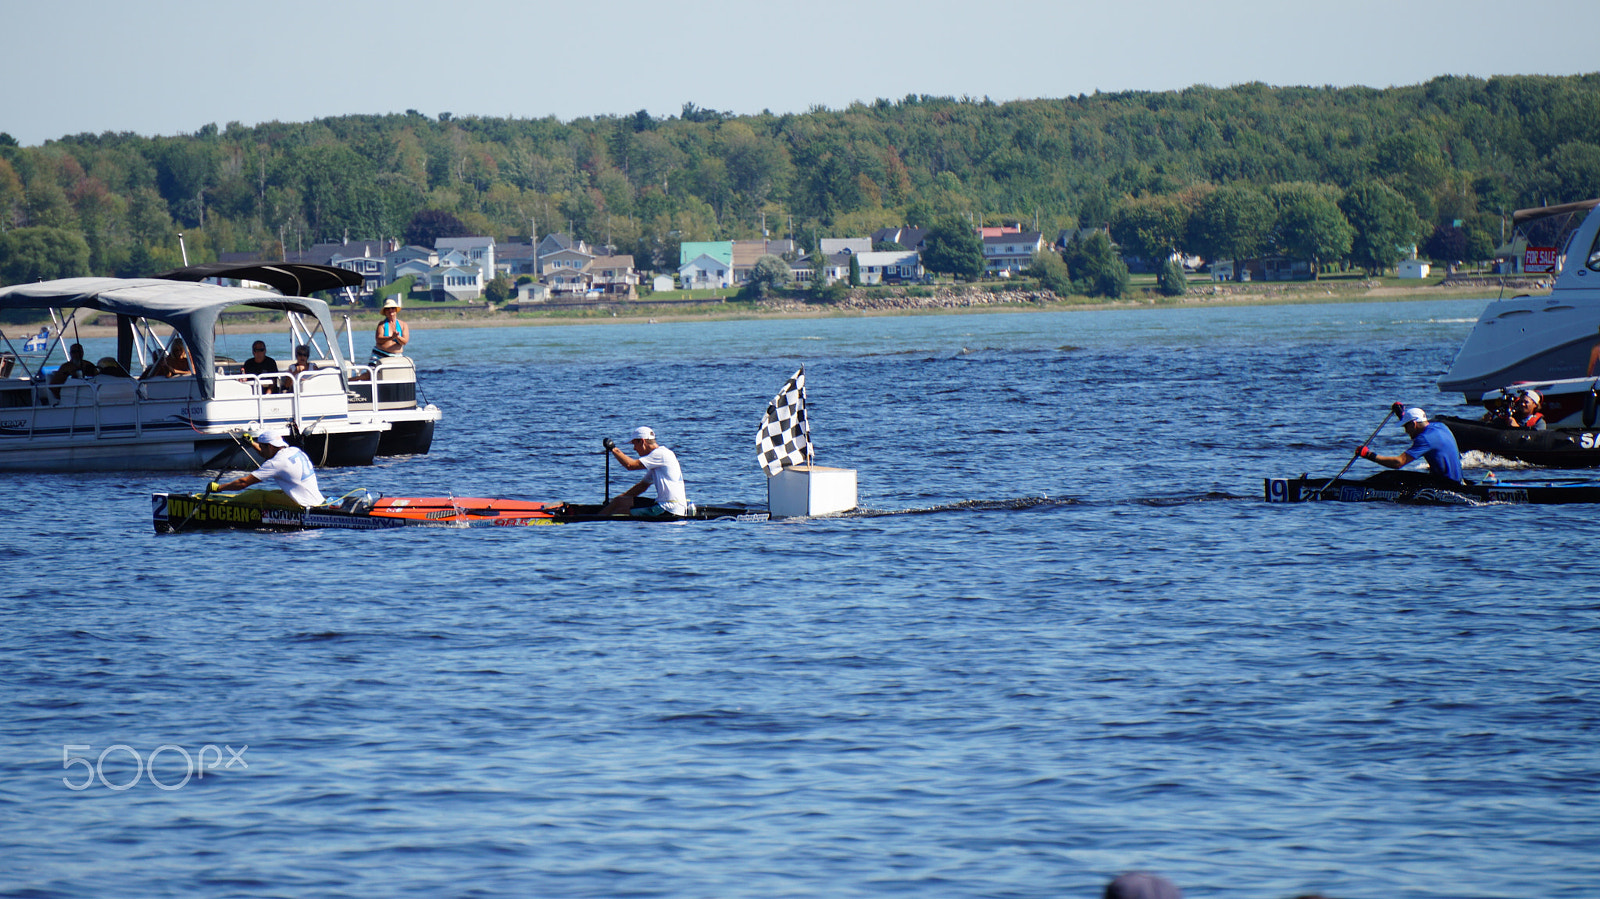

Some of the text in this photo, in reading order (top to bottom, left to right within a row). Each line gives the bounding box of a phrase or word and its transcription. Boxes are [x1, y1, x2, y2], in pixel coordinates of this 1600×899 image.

[1527, 250, 1557, 264] FOR SALE
[1271, 479, 1285, 501] 9
[153, 494, 168, 520] 2
[209, 504, 250, 523] OCEAN
